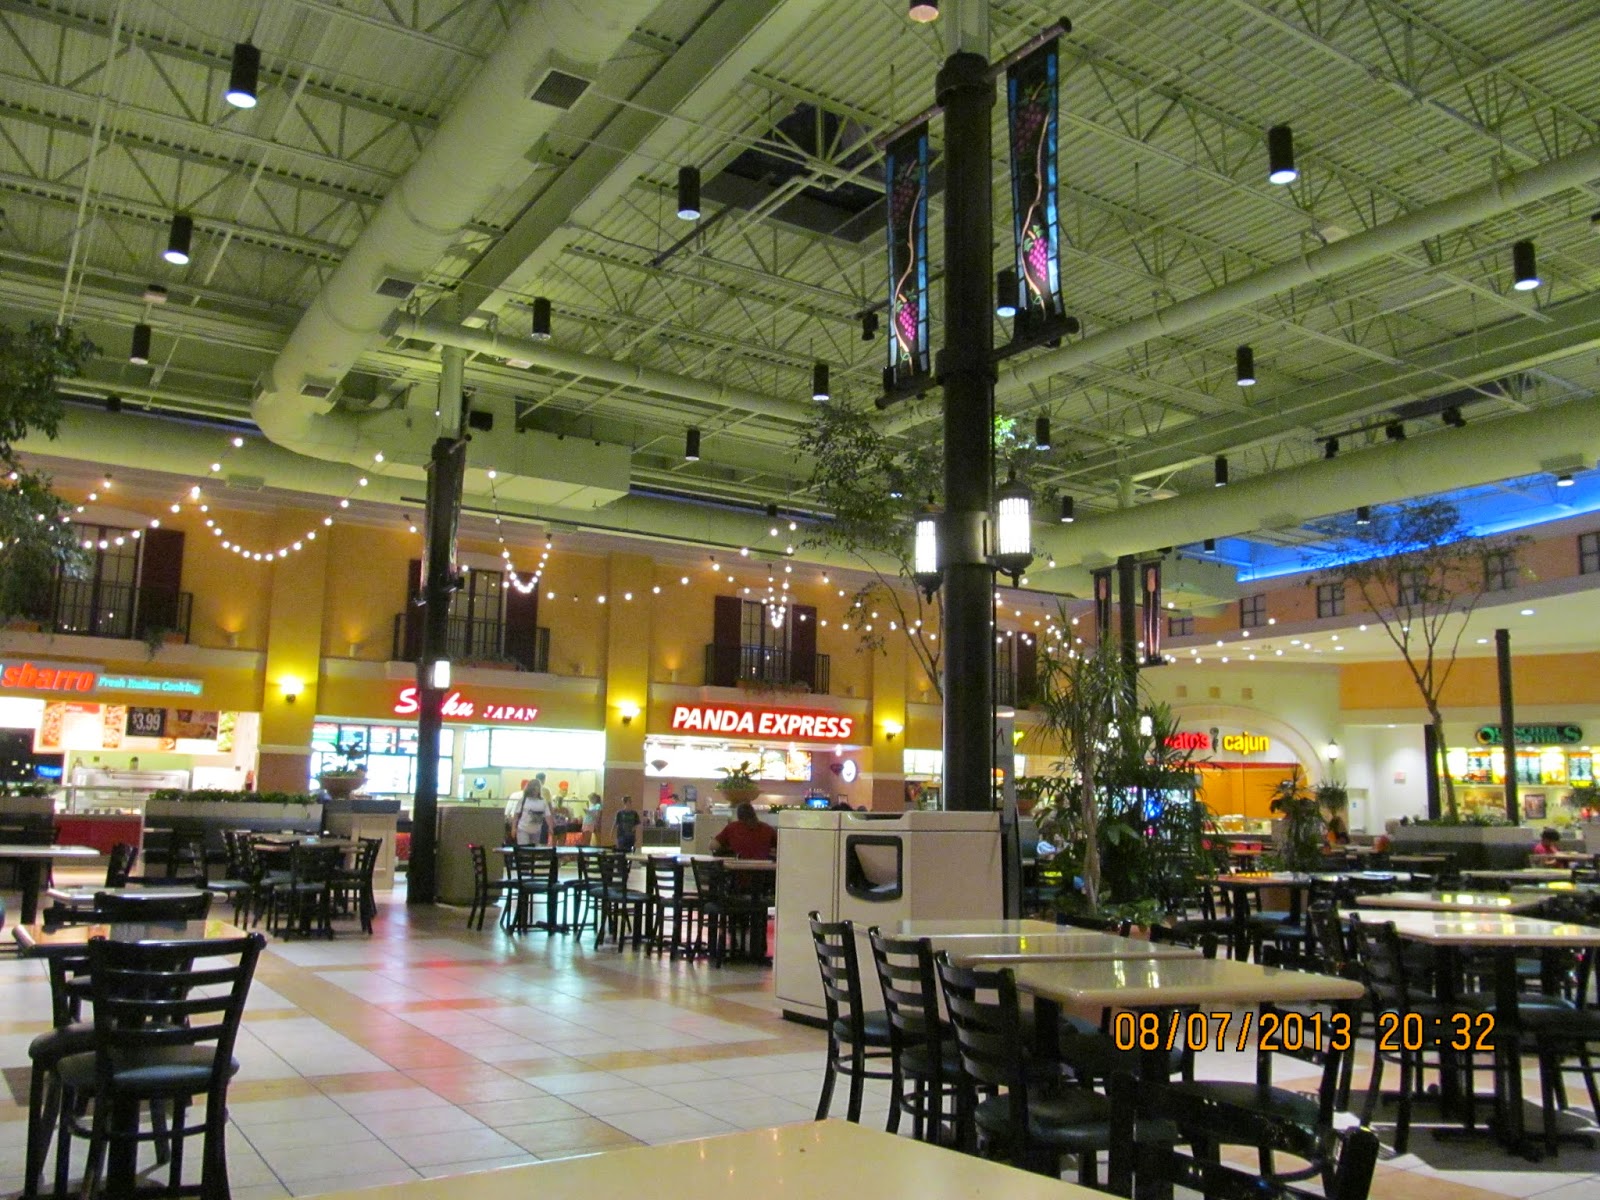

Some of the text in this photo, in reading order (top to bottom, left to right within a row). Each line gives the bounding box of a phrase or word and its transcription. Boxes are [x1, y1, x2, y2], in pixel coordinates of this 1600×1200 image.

[1, 661, 95, 692] sbarro
[394, 687, 538, 721] Sku JAPAN
[672, 706, 853, 738] PANDA EXPRESS
[1223, 731, 1271, 755] cajun
